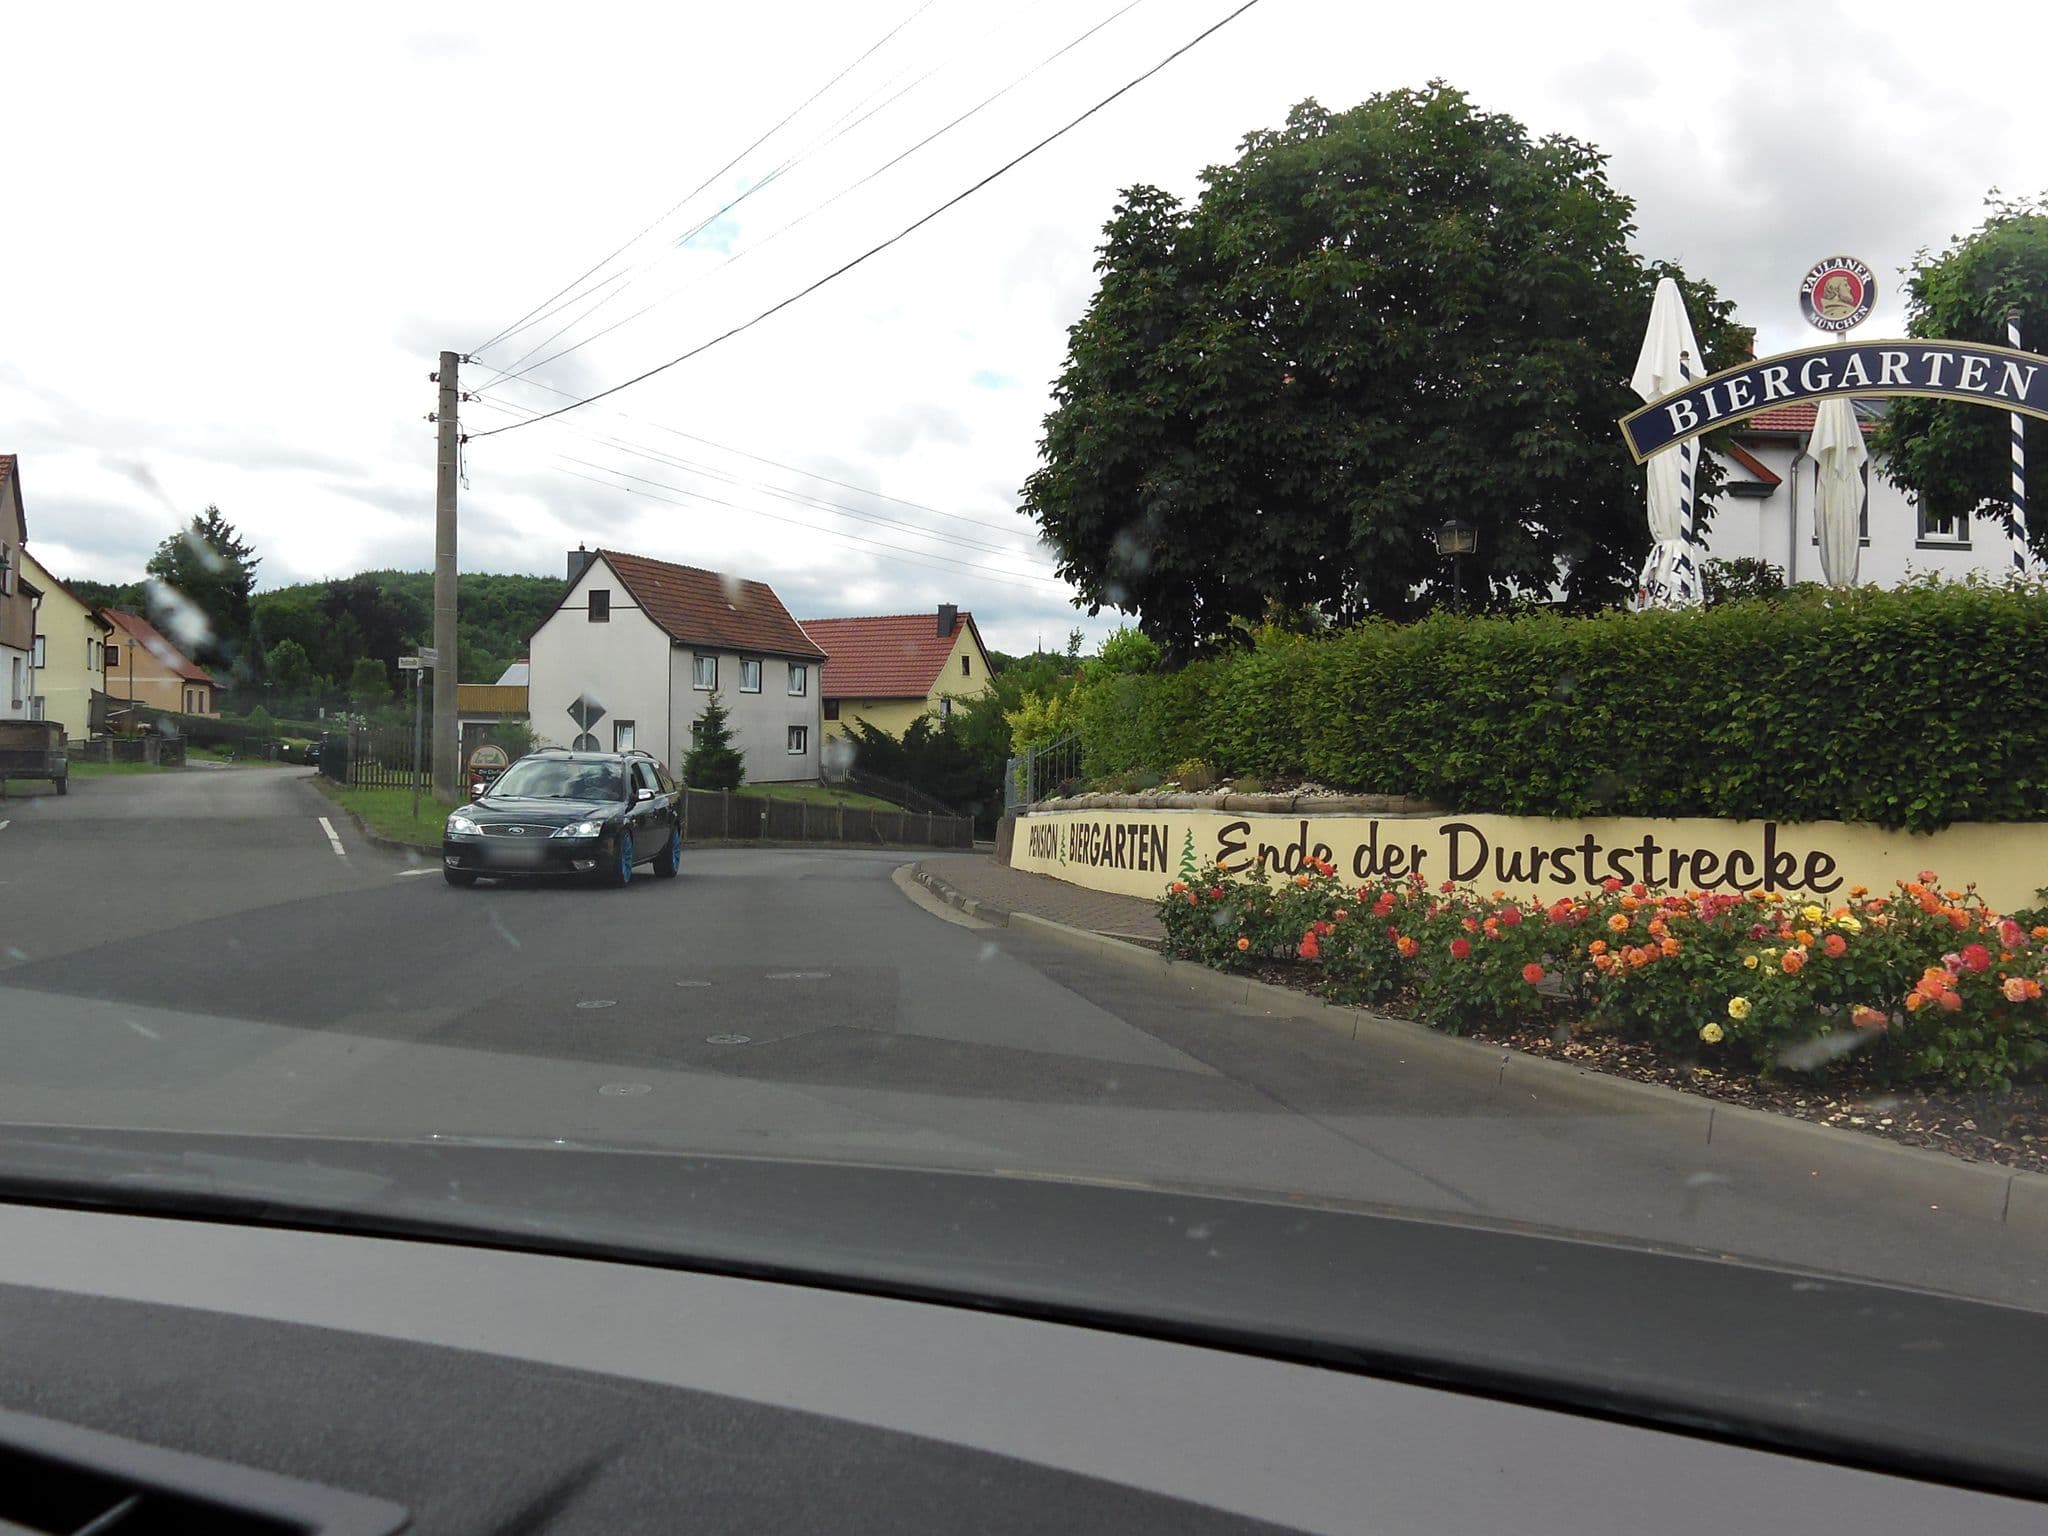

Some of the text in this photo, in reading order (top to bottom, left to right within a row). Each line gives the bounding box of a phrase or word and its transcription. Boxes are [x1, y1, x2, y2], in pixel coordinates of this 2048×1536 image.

[1802, 258, 1872, 293] PAULANER
[1665, 351, 2038, 435] BIERGARTEN
[1028, 822, 1168, 873] PENSION BIERGARTEN
[1216, 820, 1843, 894] Ende der Durststrecke
